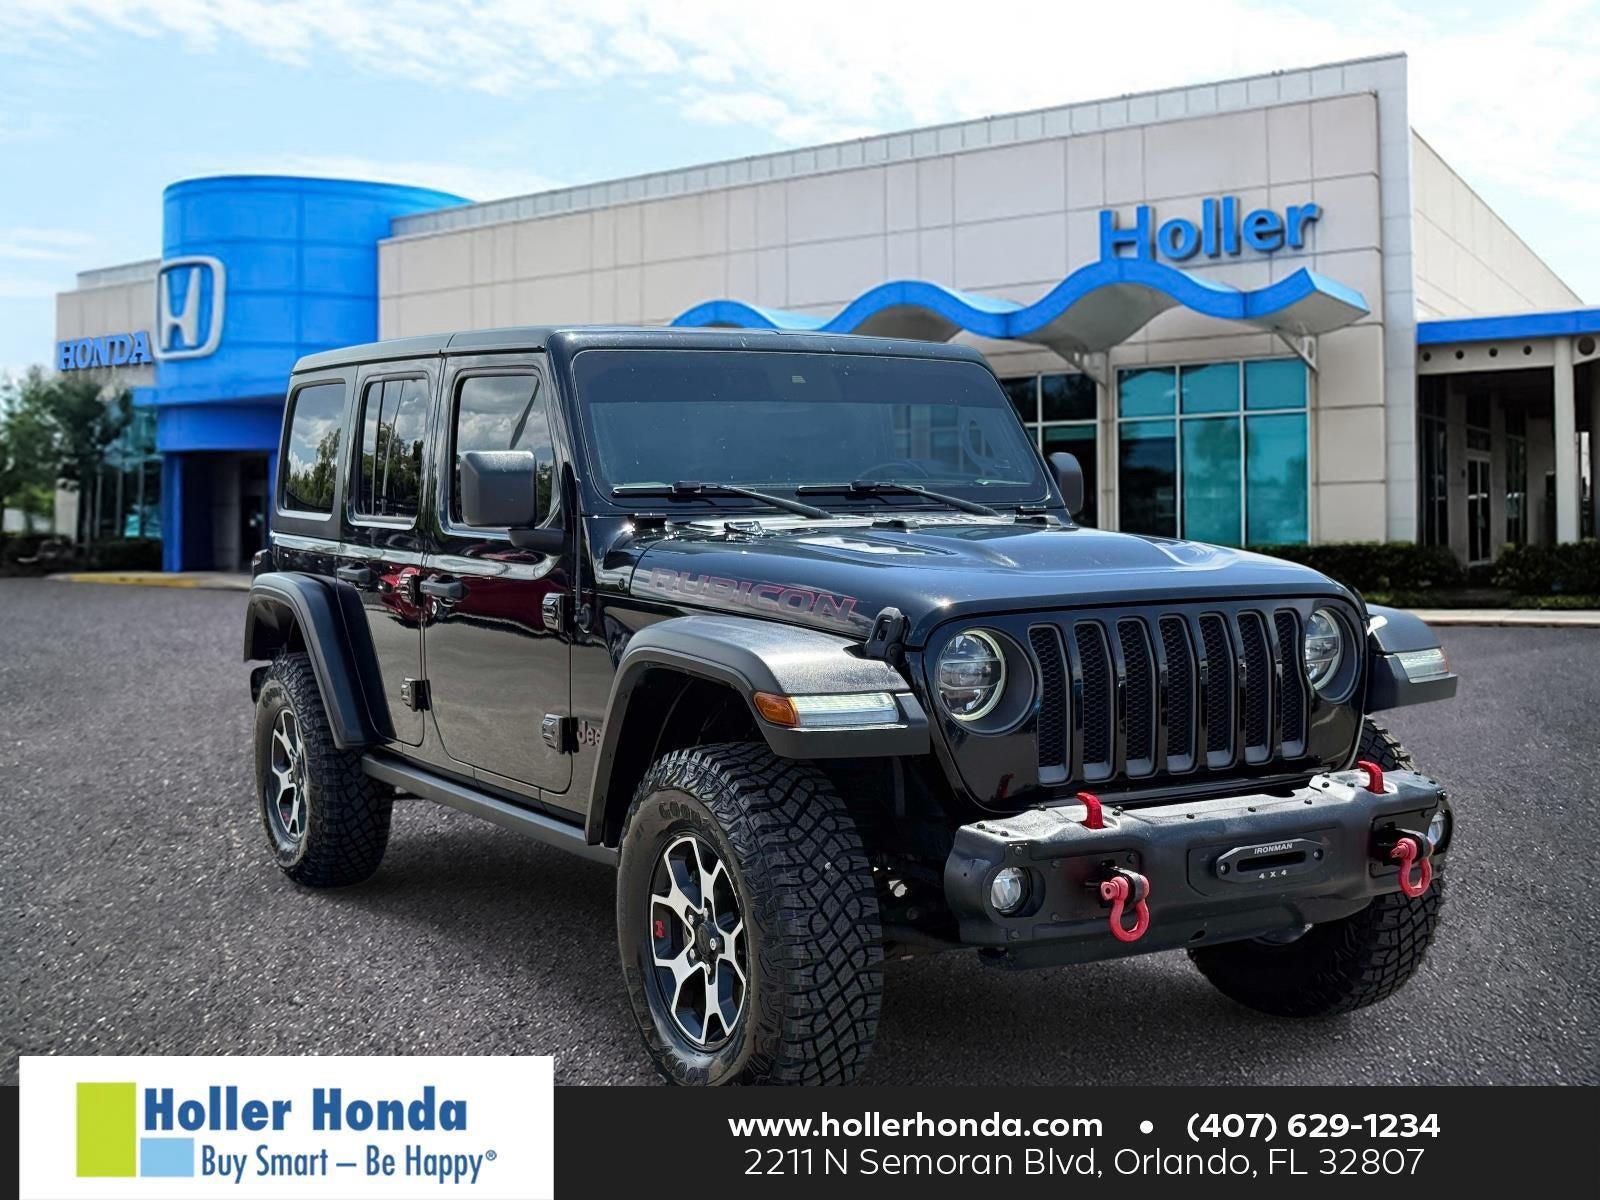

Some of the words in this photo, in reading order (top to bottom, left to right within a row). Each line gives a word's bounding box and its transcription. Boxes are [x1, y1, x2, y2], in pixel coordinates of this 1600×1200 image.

[1099, 196, 1322, 261] Holler
[58, 331, 153, 371] HONDA
[650, 568, 857, 620] RUBICON
[577, 720, 601, 747] Jee
[1254, 842, 1293, 855] IRONMAN
